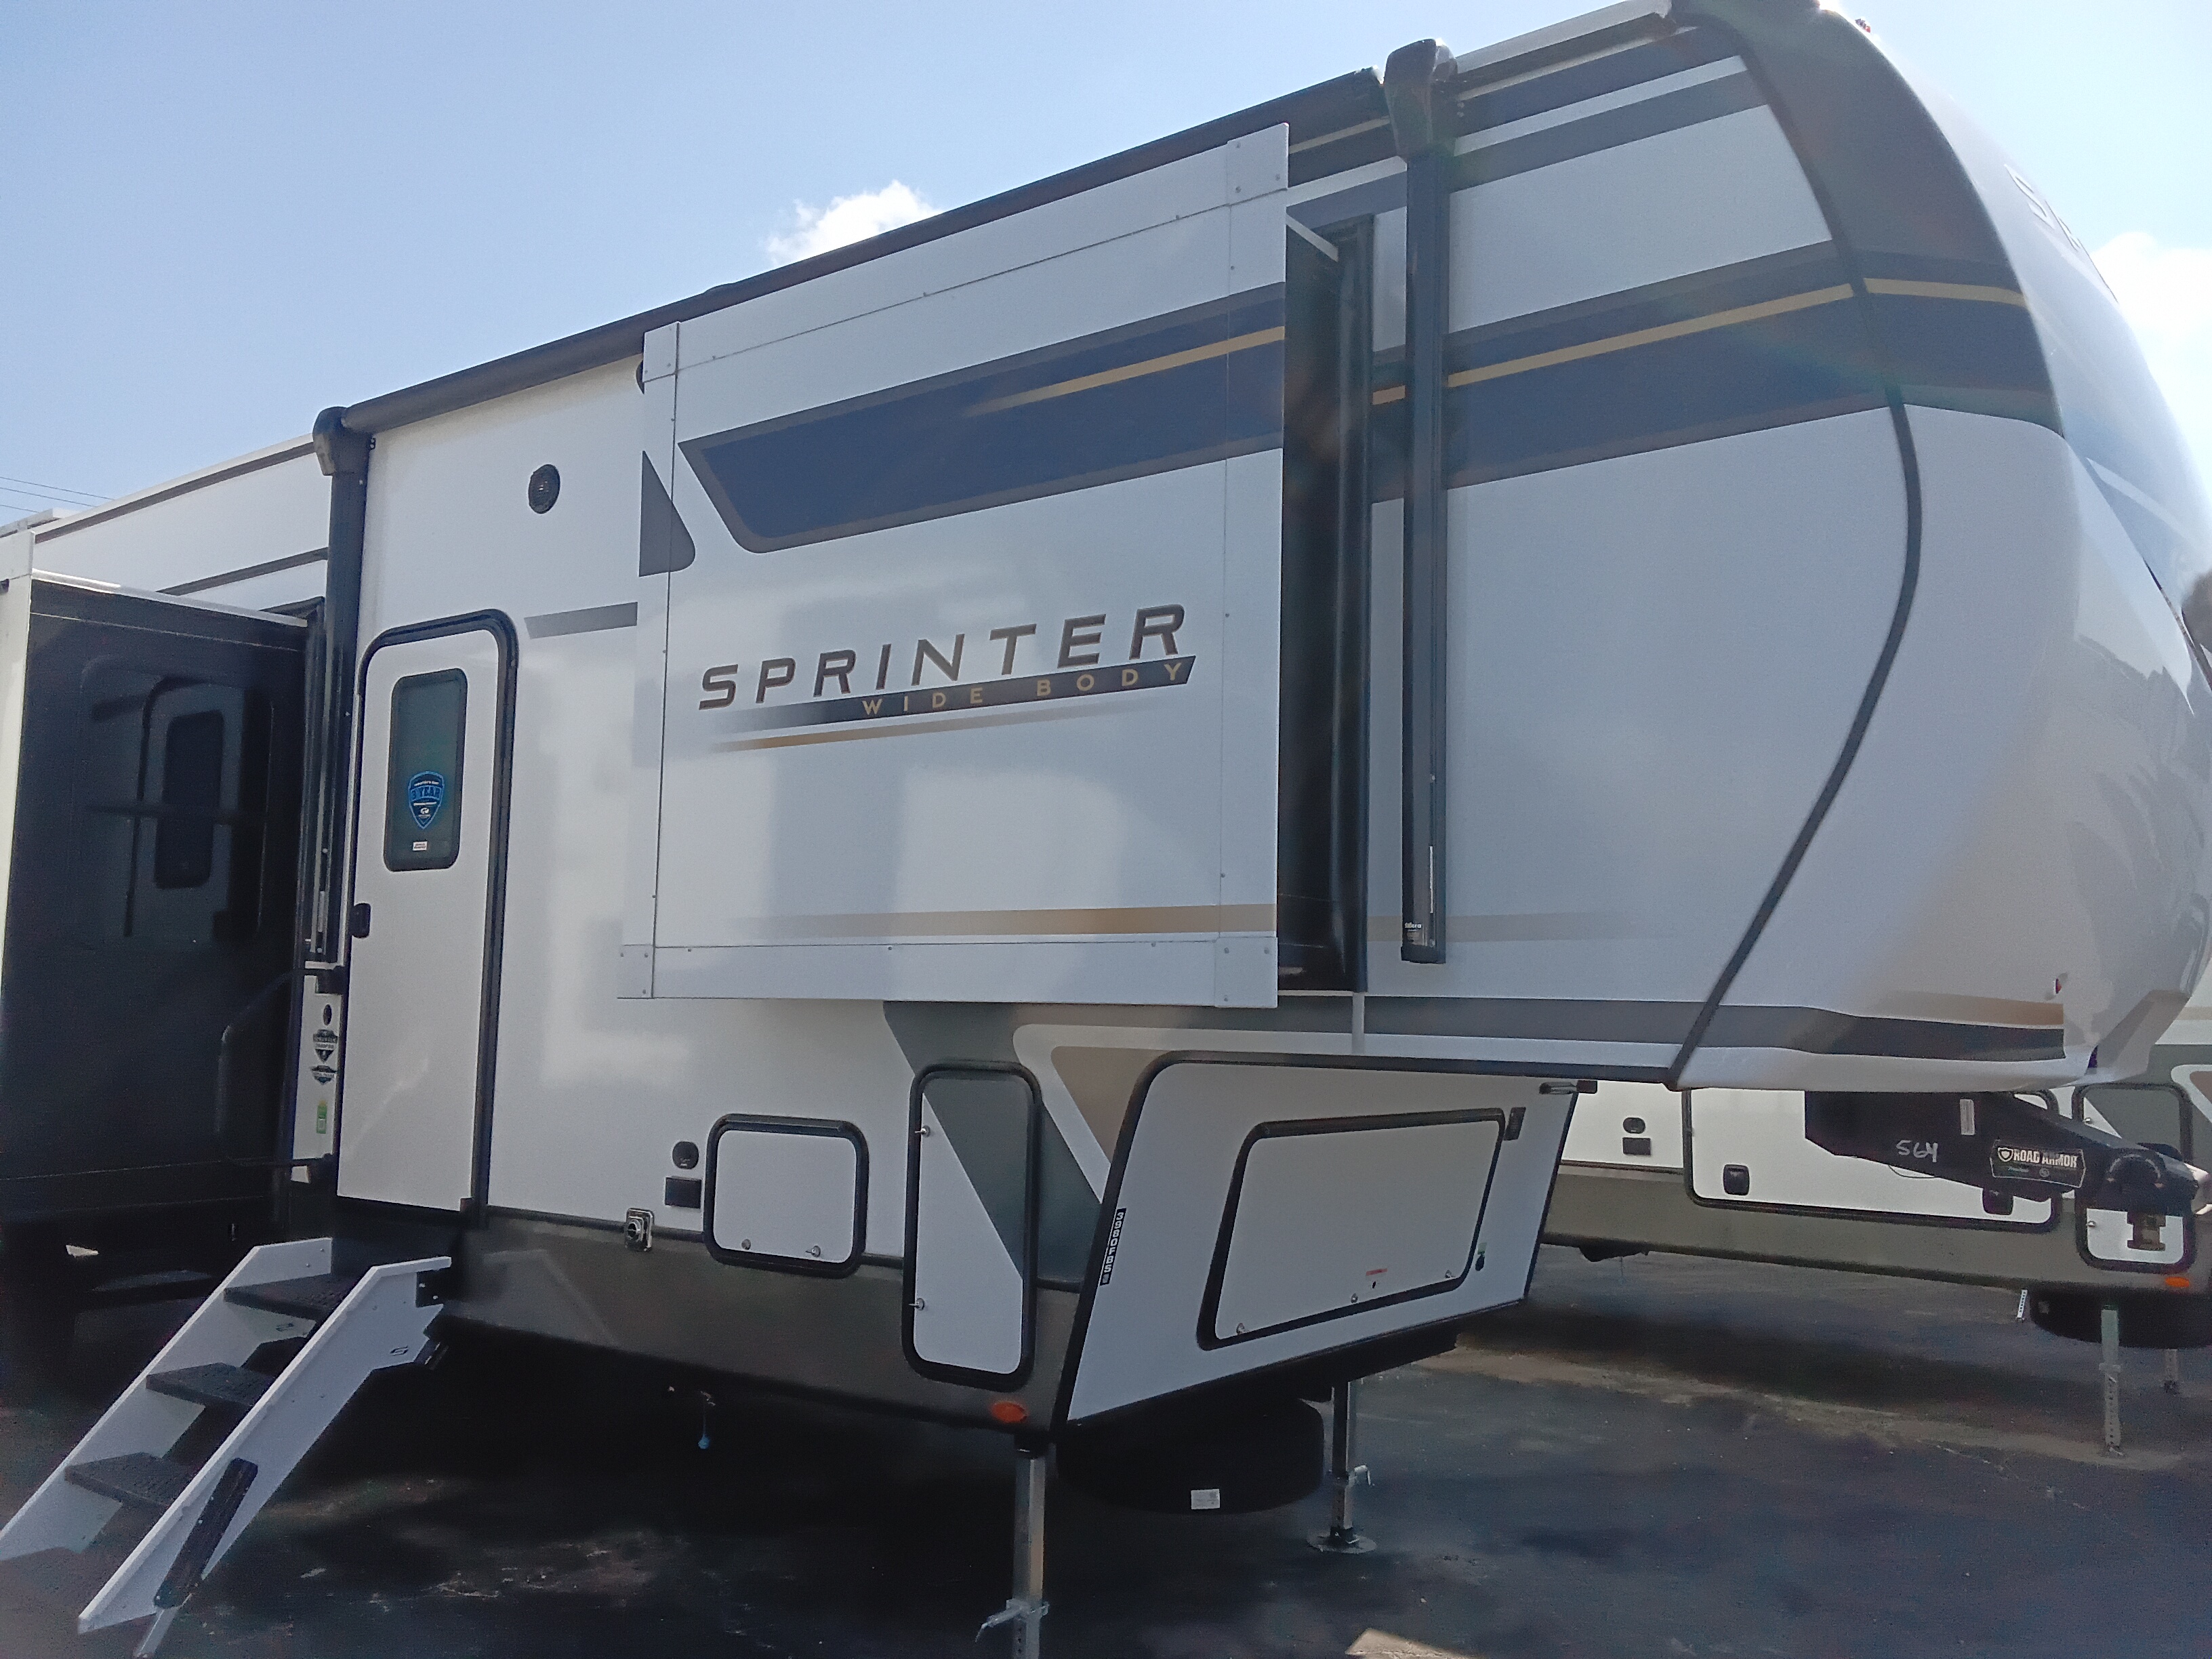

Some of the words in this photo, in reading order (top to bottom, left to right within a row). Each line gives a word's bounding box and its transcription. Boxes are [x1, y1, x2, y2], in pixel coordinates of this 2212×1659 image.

[699, 604, 1185, 710] SPRINTER
[862, 687, 983, 716] WIDE
[1037, 662, 1182, 697] BODY
[1896, 1140, 1938, 1163] 564
[2013, 1149, 2040, 1164] ROAD
[2042, 1151, 2078, 1168] ARMOR
